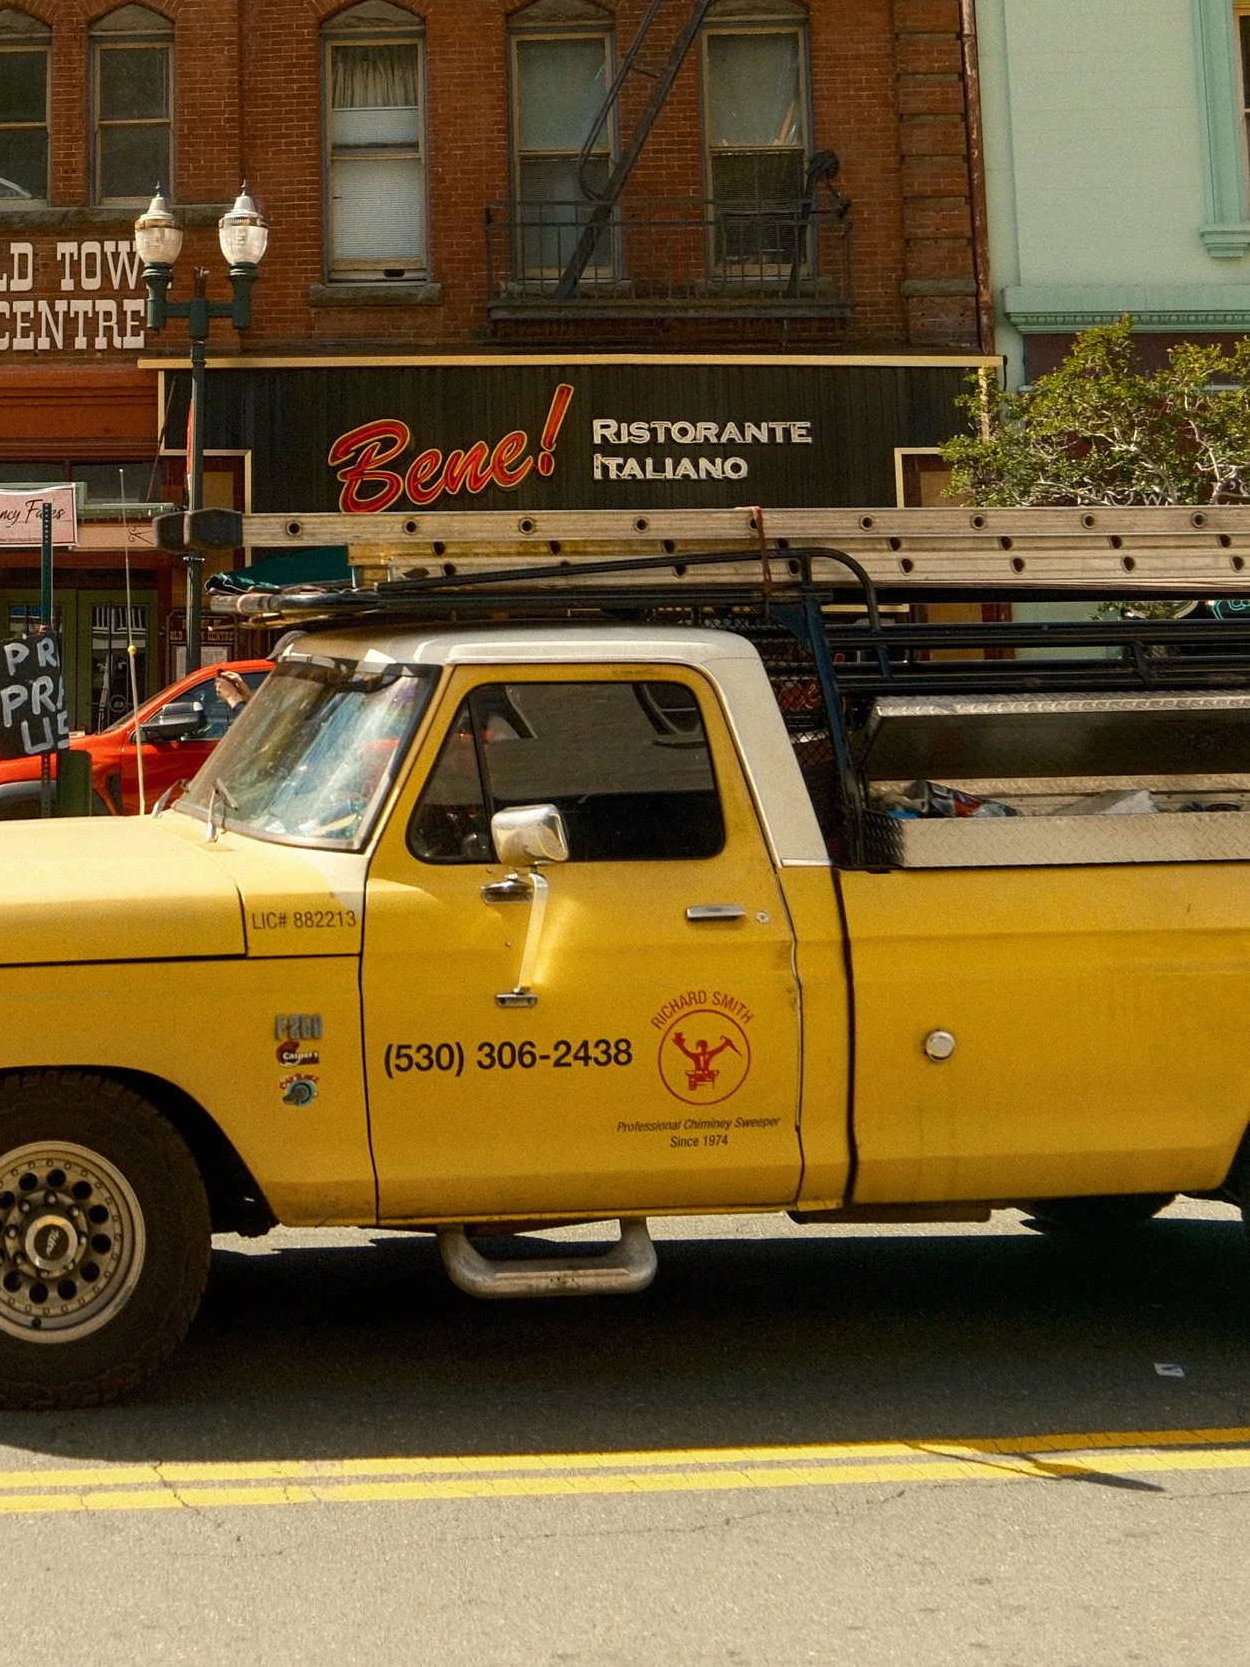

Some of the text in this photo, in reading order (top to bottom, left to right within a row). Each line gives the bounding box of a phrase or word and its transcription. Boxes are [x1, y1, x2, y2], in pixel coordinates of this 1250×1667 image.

[56, 240, 172, 291] TOW
[593, 419, 812, 444] RISTORANTE
[328, 383, 575, 513] Bene!
[593, 453, 749, 480] ITALIANO
[25, 499, 66, 524] Faes
[251, 910, 357, 930] LIC# 882213
[650, 990, 755, 1031] RICHARD SMITH
[383, 1037, 633, 1080] (530) 306-2438
[616, 1119, 682, 1133] Professional
[733, 1115, 782, 1131] Sweeper
[669, 1134, 729, 1148] Since 1974
